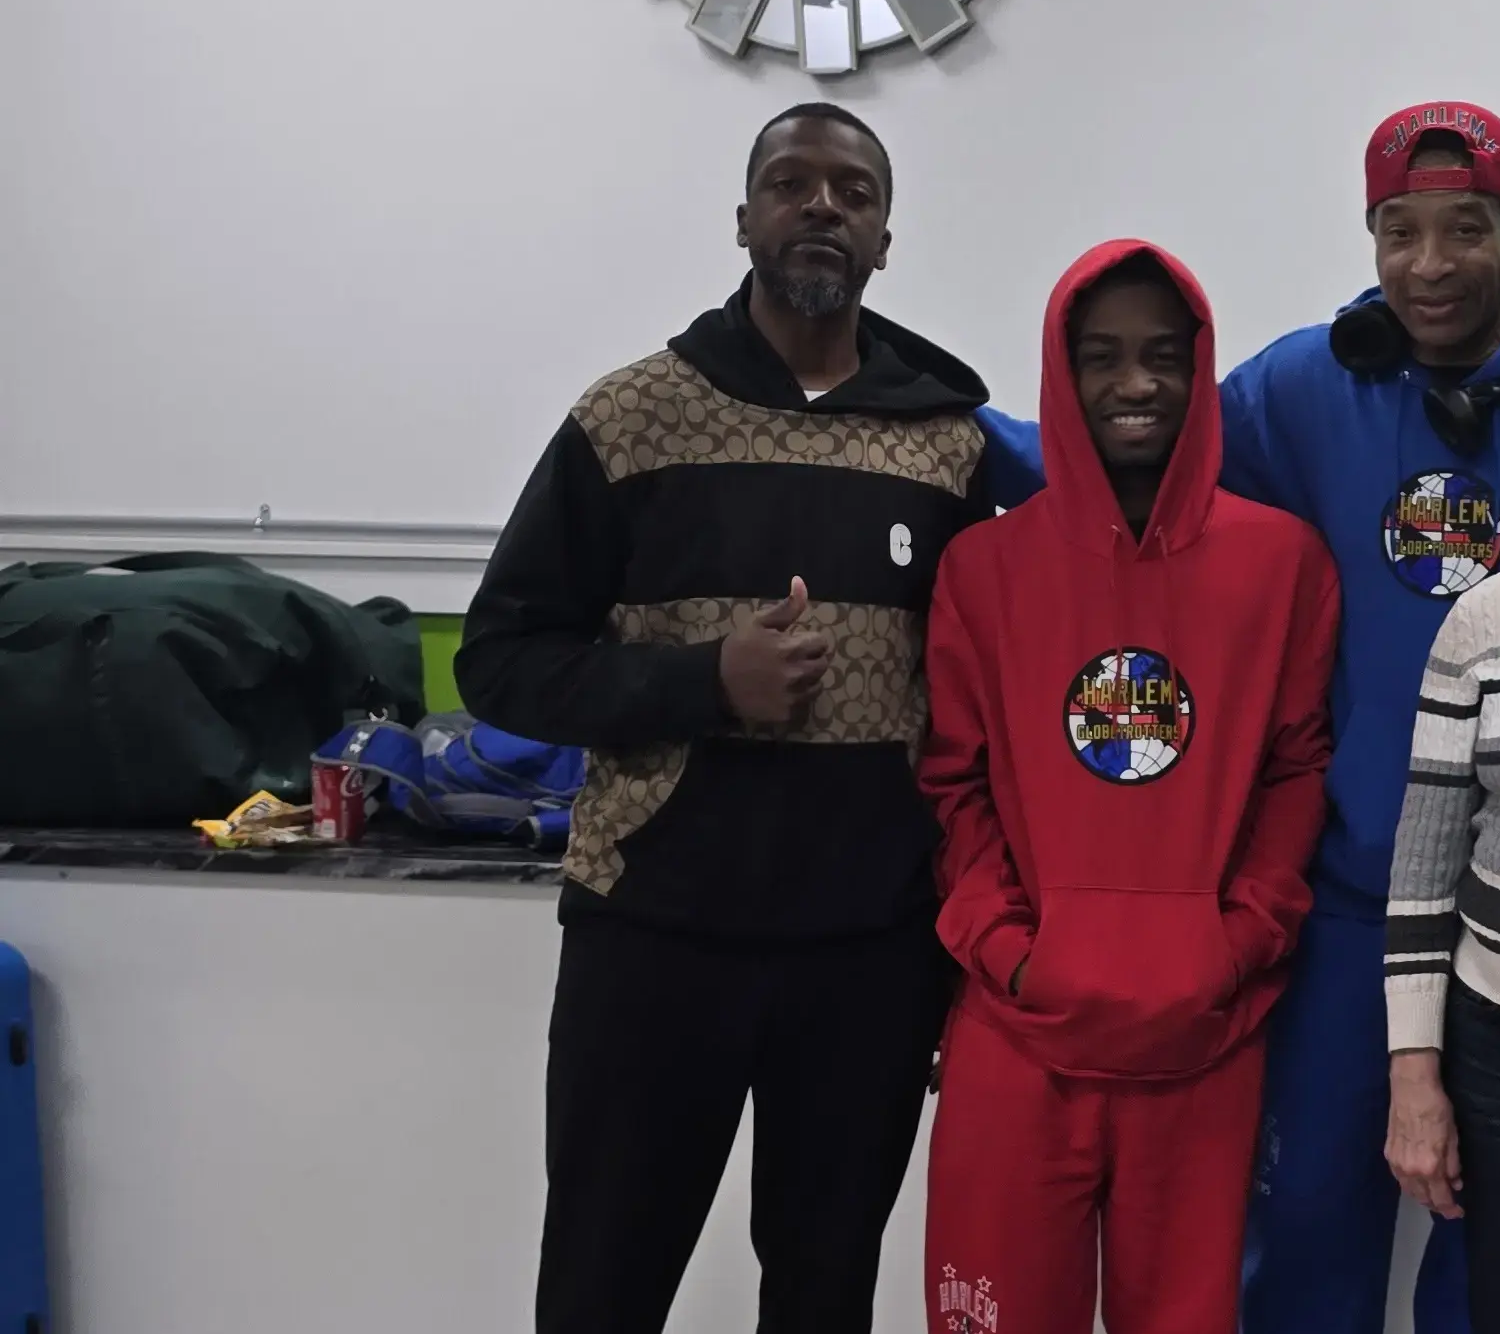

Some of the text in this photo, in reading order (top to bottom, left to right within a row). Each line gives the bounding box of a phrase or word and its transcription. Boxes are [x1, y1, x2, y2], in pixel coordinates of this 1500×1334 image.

[1393, 106, 1489, 149] HARLEM
[1399, 495, 1489, 525] HARLEM
[1082, 678, 1174, 706] HARLEM
